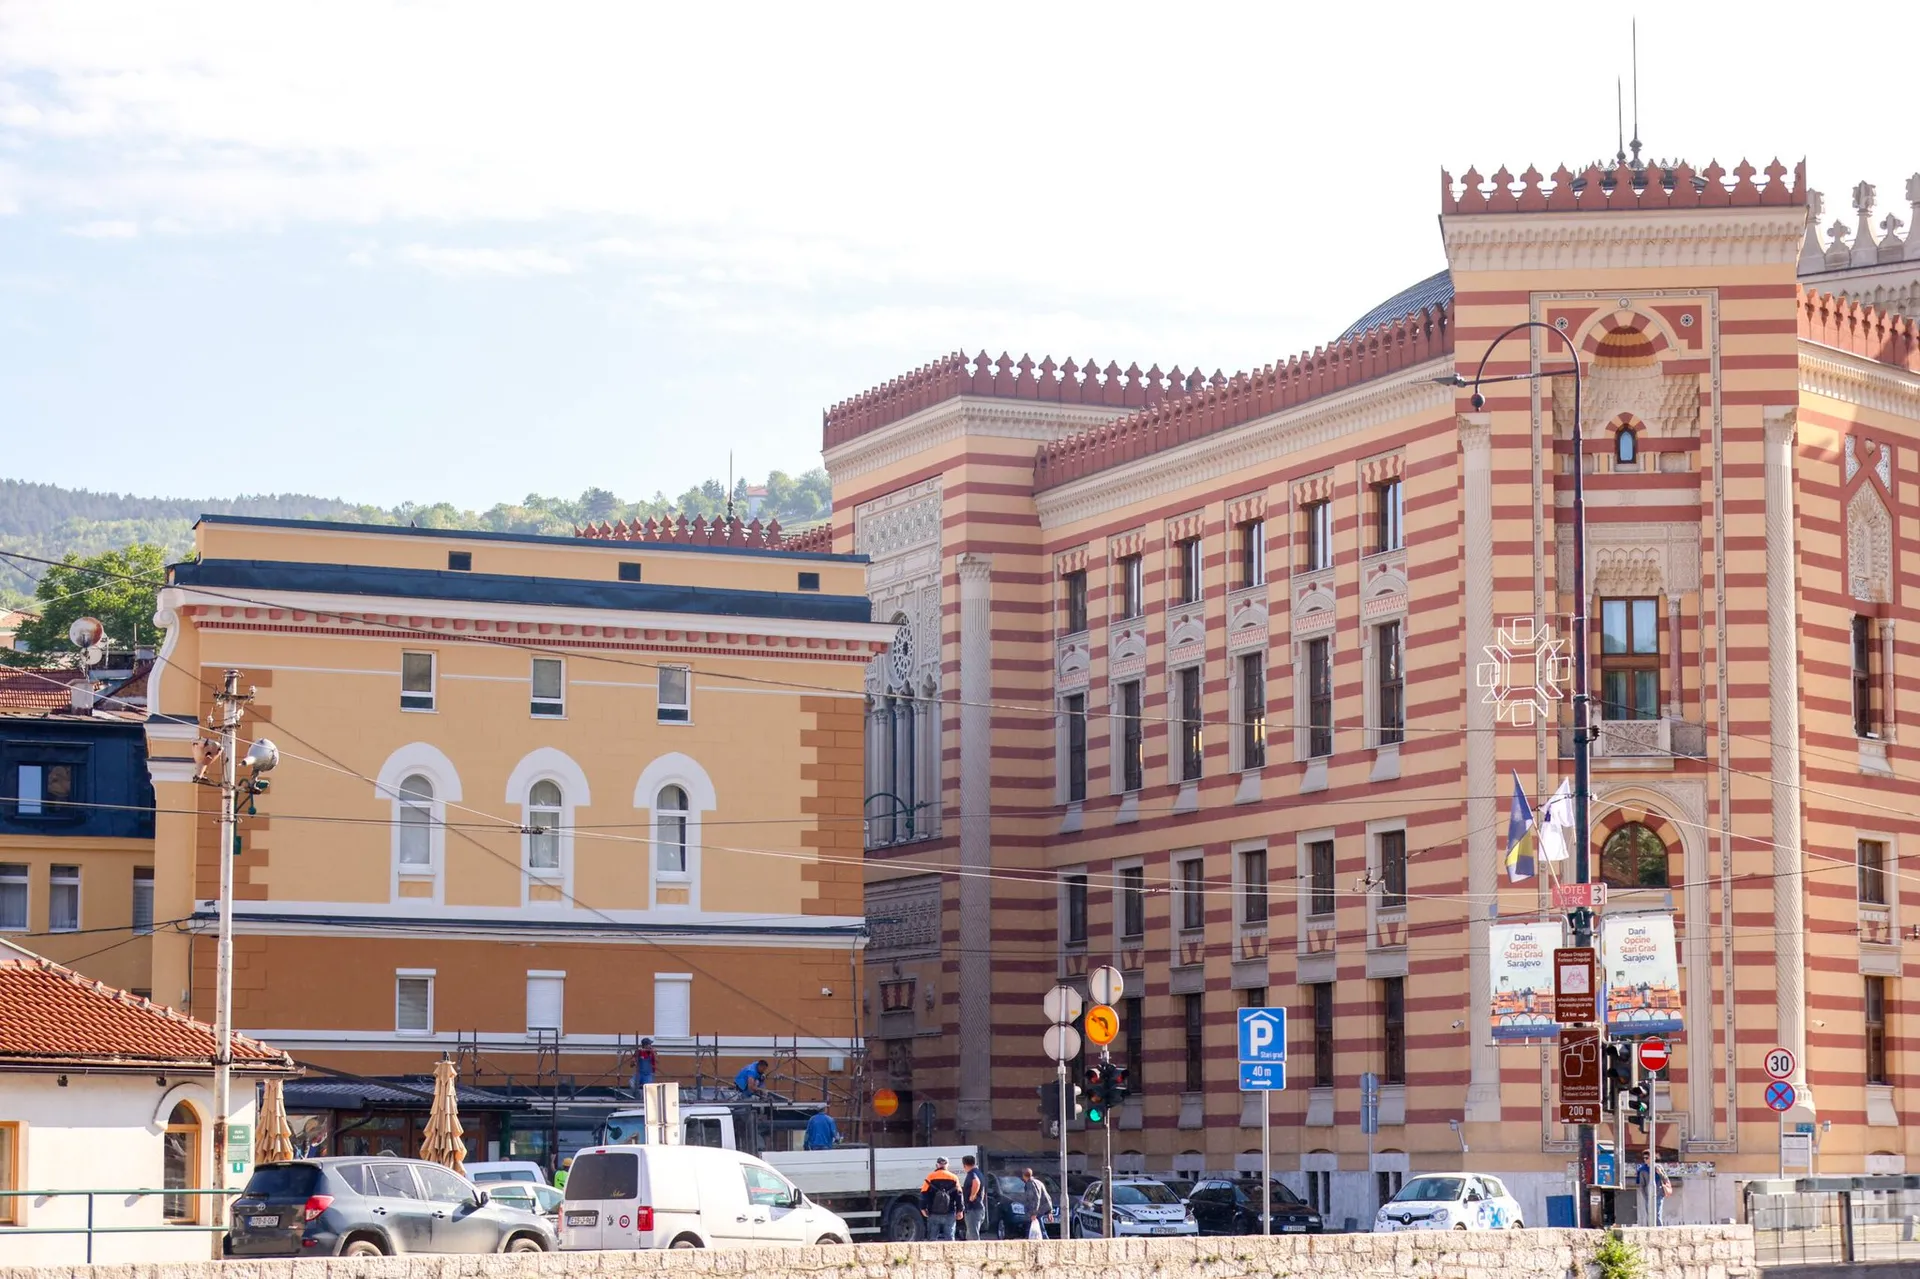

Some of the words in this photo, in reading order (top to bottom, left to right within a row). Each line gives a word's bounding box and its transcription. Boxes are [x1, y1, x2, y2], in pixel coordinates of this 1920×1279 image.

[1557, 885, 1587, 895] HOTEL
[1628, 926, 1646, 936] Dani
[1514, 932, 1533, 941] Dani
[1619, 944, 1637, 954] Stari
[1638, 943, 1657, 952] Grad
[1504, 950, 1523, 959] Stari
[1524, 949, 1543, 958] Grad
[1622, 953, 1655, 963] Sarajevo
[1506, 959, 1541, 969] Sarajevo
[1250, 1019, 1273, 1057] P
[1260, 1051, 1271, 1059] Stari
[1272, 1051, 1284, 1060] grad
[1770, 1055, 1789, 1072] 30
[1252, 1065, 1263, 1077] 40
[1264, 1068, 1272, 1077] m
[1568, 1105, 1584, 1116] 200
[1585, 1107, 1593, 1116] m
